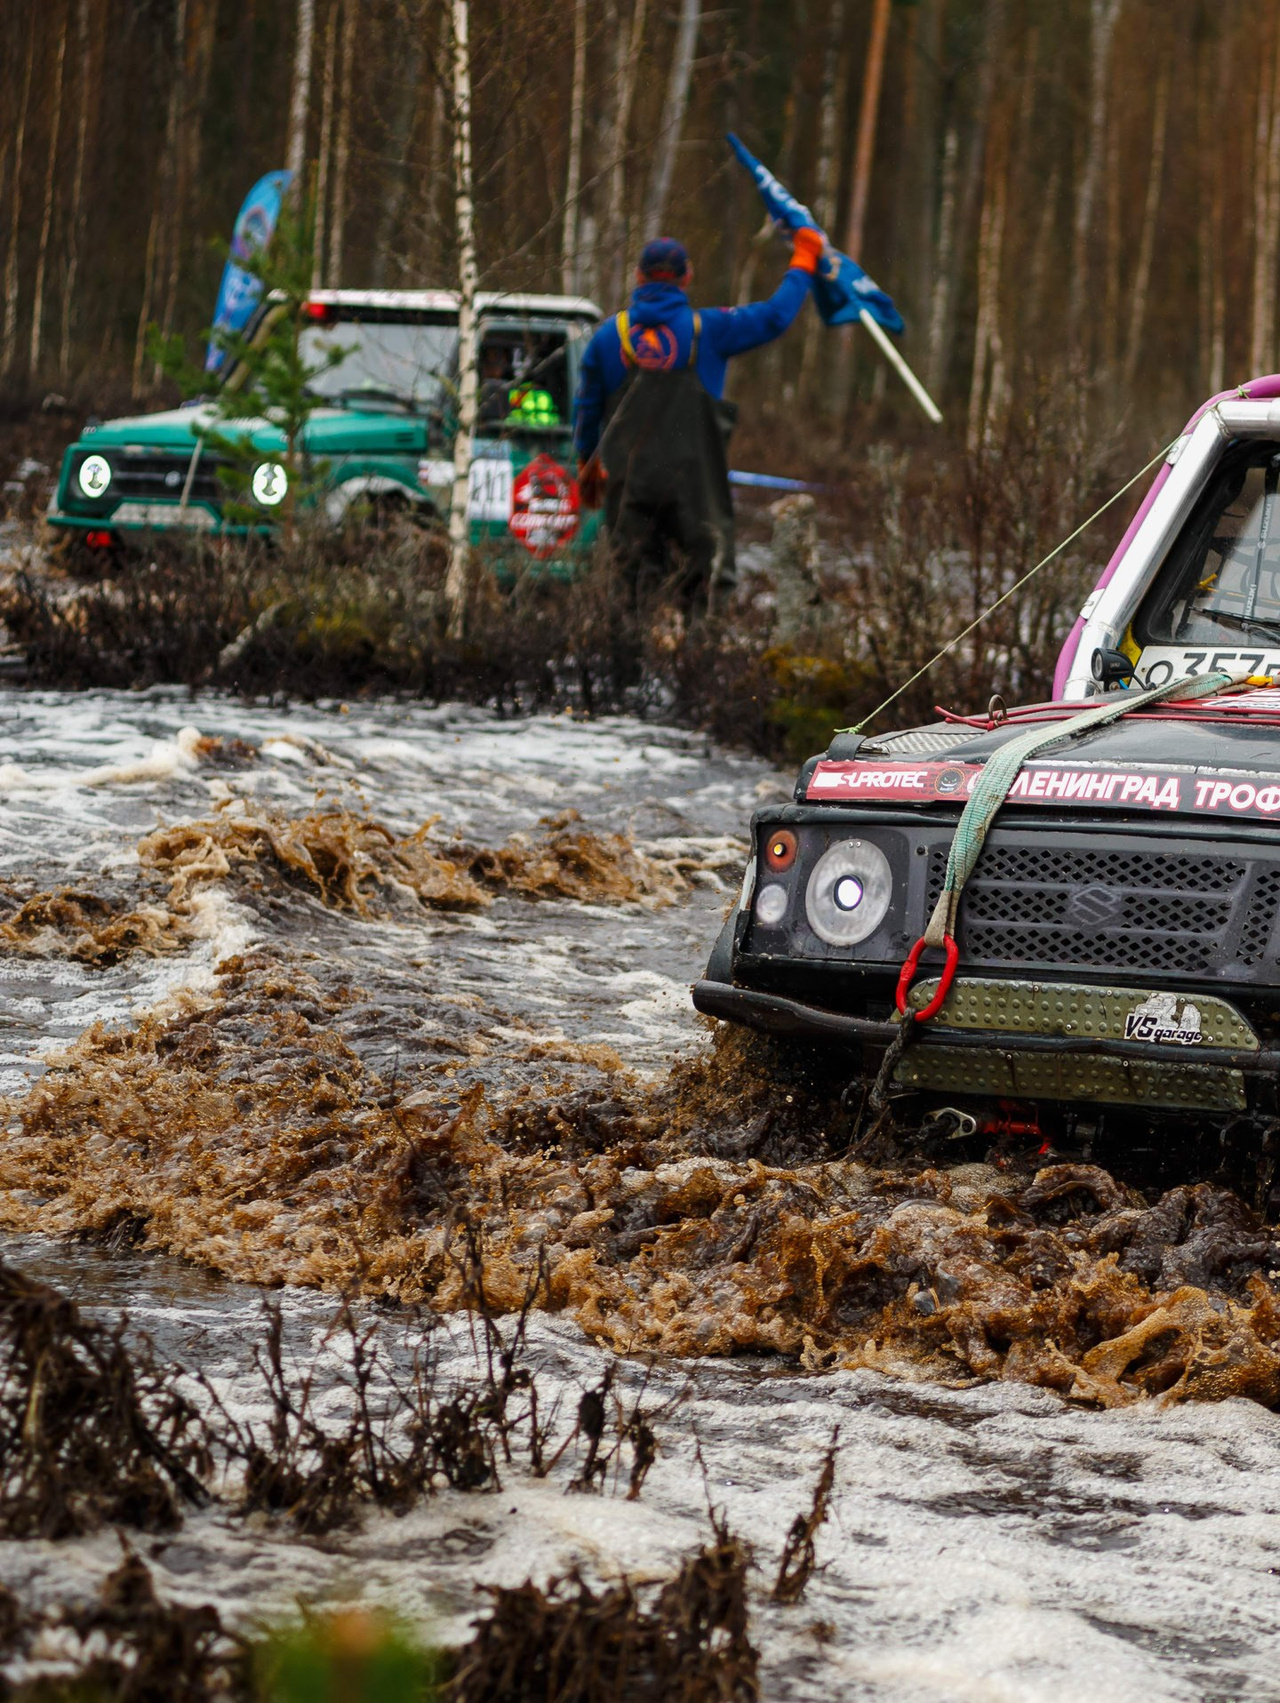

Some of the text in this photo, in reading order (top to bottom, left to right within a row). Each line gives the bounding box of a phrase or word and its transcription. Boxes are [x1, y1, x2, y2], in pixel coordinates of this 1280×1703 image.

[837, 771, 928, 788] SUPROTEC
[1008, 771, 1181, 809] ЛЕНИНГРАД
[1125, 1015, 1202, 1044] VS garage
